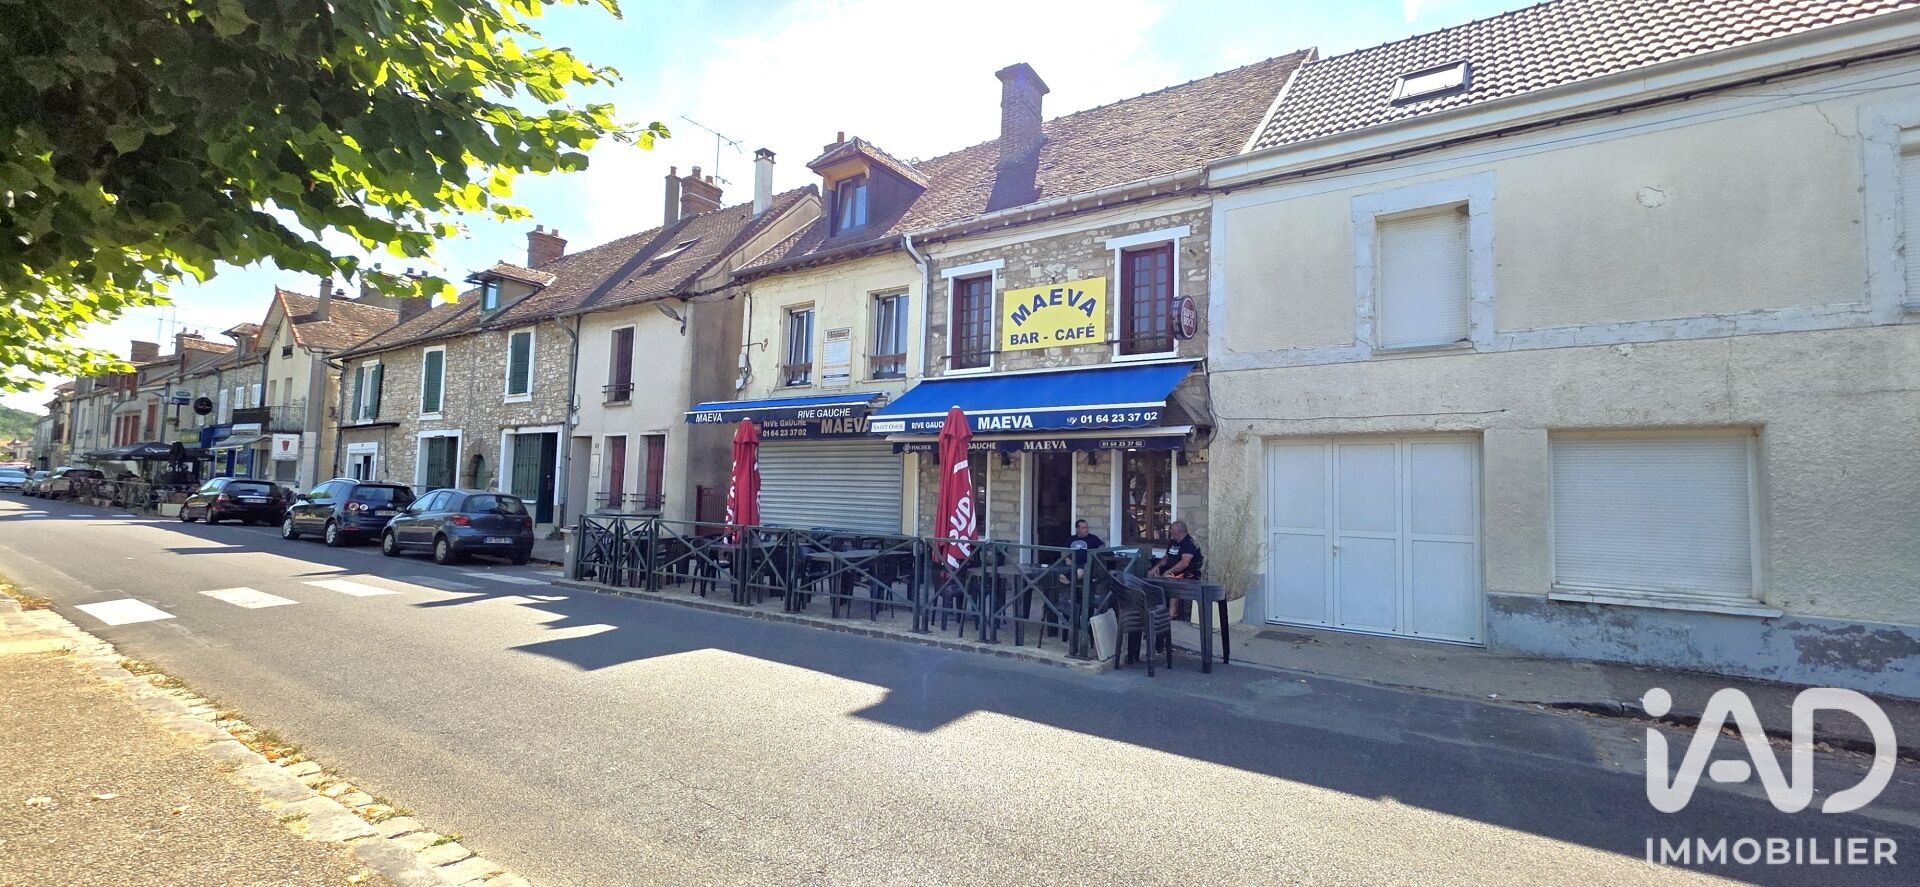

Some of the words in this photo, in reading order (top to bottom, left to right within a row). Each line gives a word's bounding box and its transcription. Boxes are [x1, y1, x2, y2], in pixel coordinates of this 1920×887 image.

[1011, 288, 1096, 327] MAEVA
[1010, 332, 1039, 345] BAR
[1055, 323, 1095, 341] CAFÉ
[696, 412, 723, 423] MAEVA
[797, 410, 815, 419] RIVE
[816, 408, 851, 418] GAUCHE
[1080, 415, 1092, 424] 01
[1096, 414, 1109, 423] 64
[1111, 413, 1125, 422] 23
[1127, 412, 1141, 422] 37
[1144, 411, 1158, 421] 02
[779, 419, 807, 427] GAUCHE
[821, 417, 868, 434] MAEVA
[911, 421, 924, 430] RIVE
[925, 421, 944, 429] GAUC
[977, 415, 1034, 430] MAEVA
[780, 429, 789, 437] 23
[798, 428, 807, 436] 02
[1023, 440, 1067, 450] MAEVA
